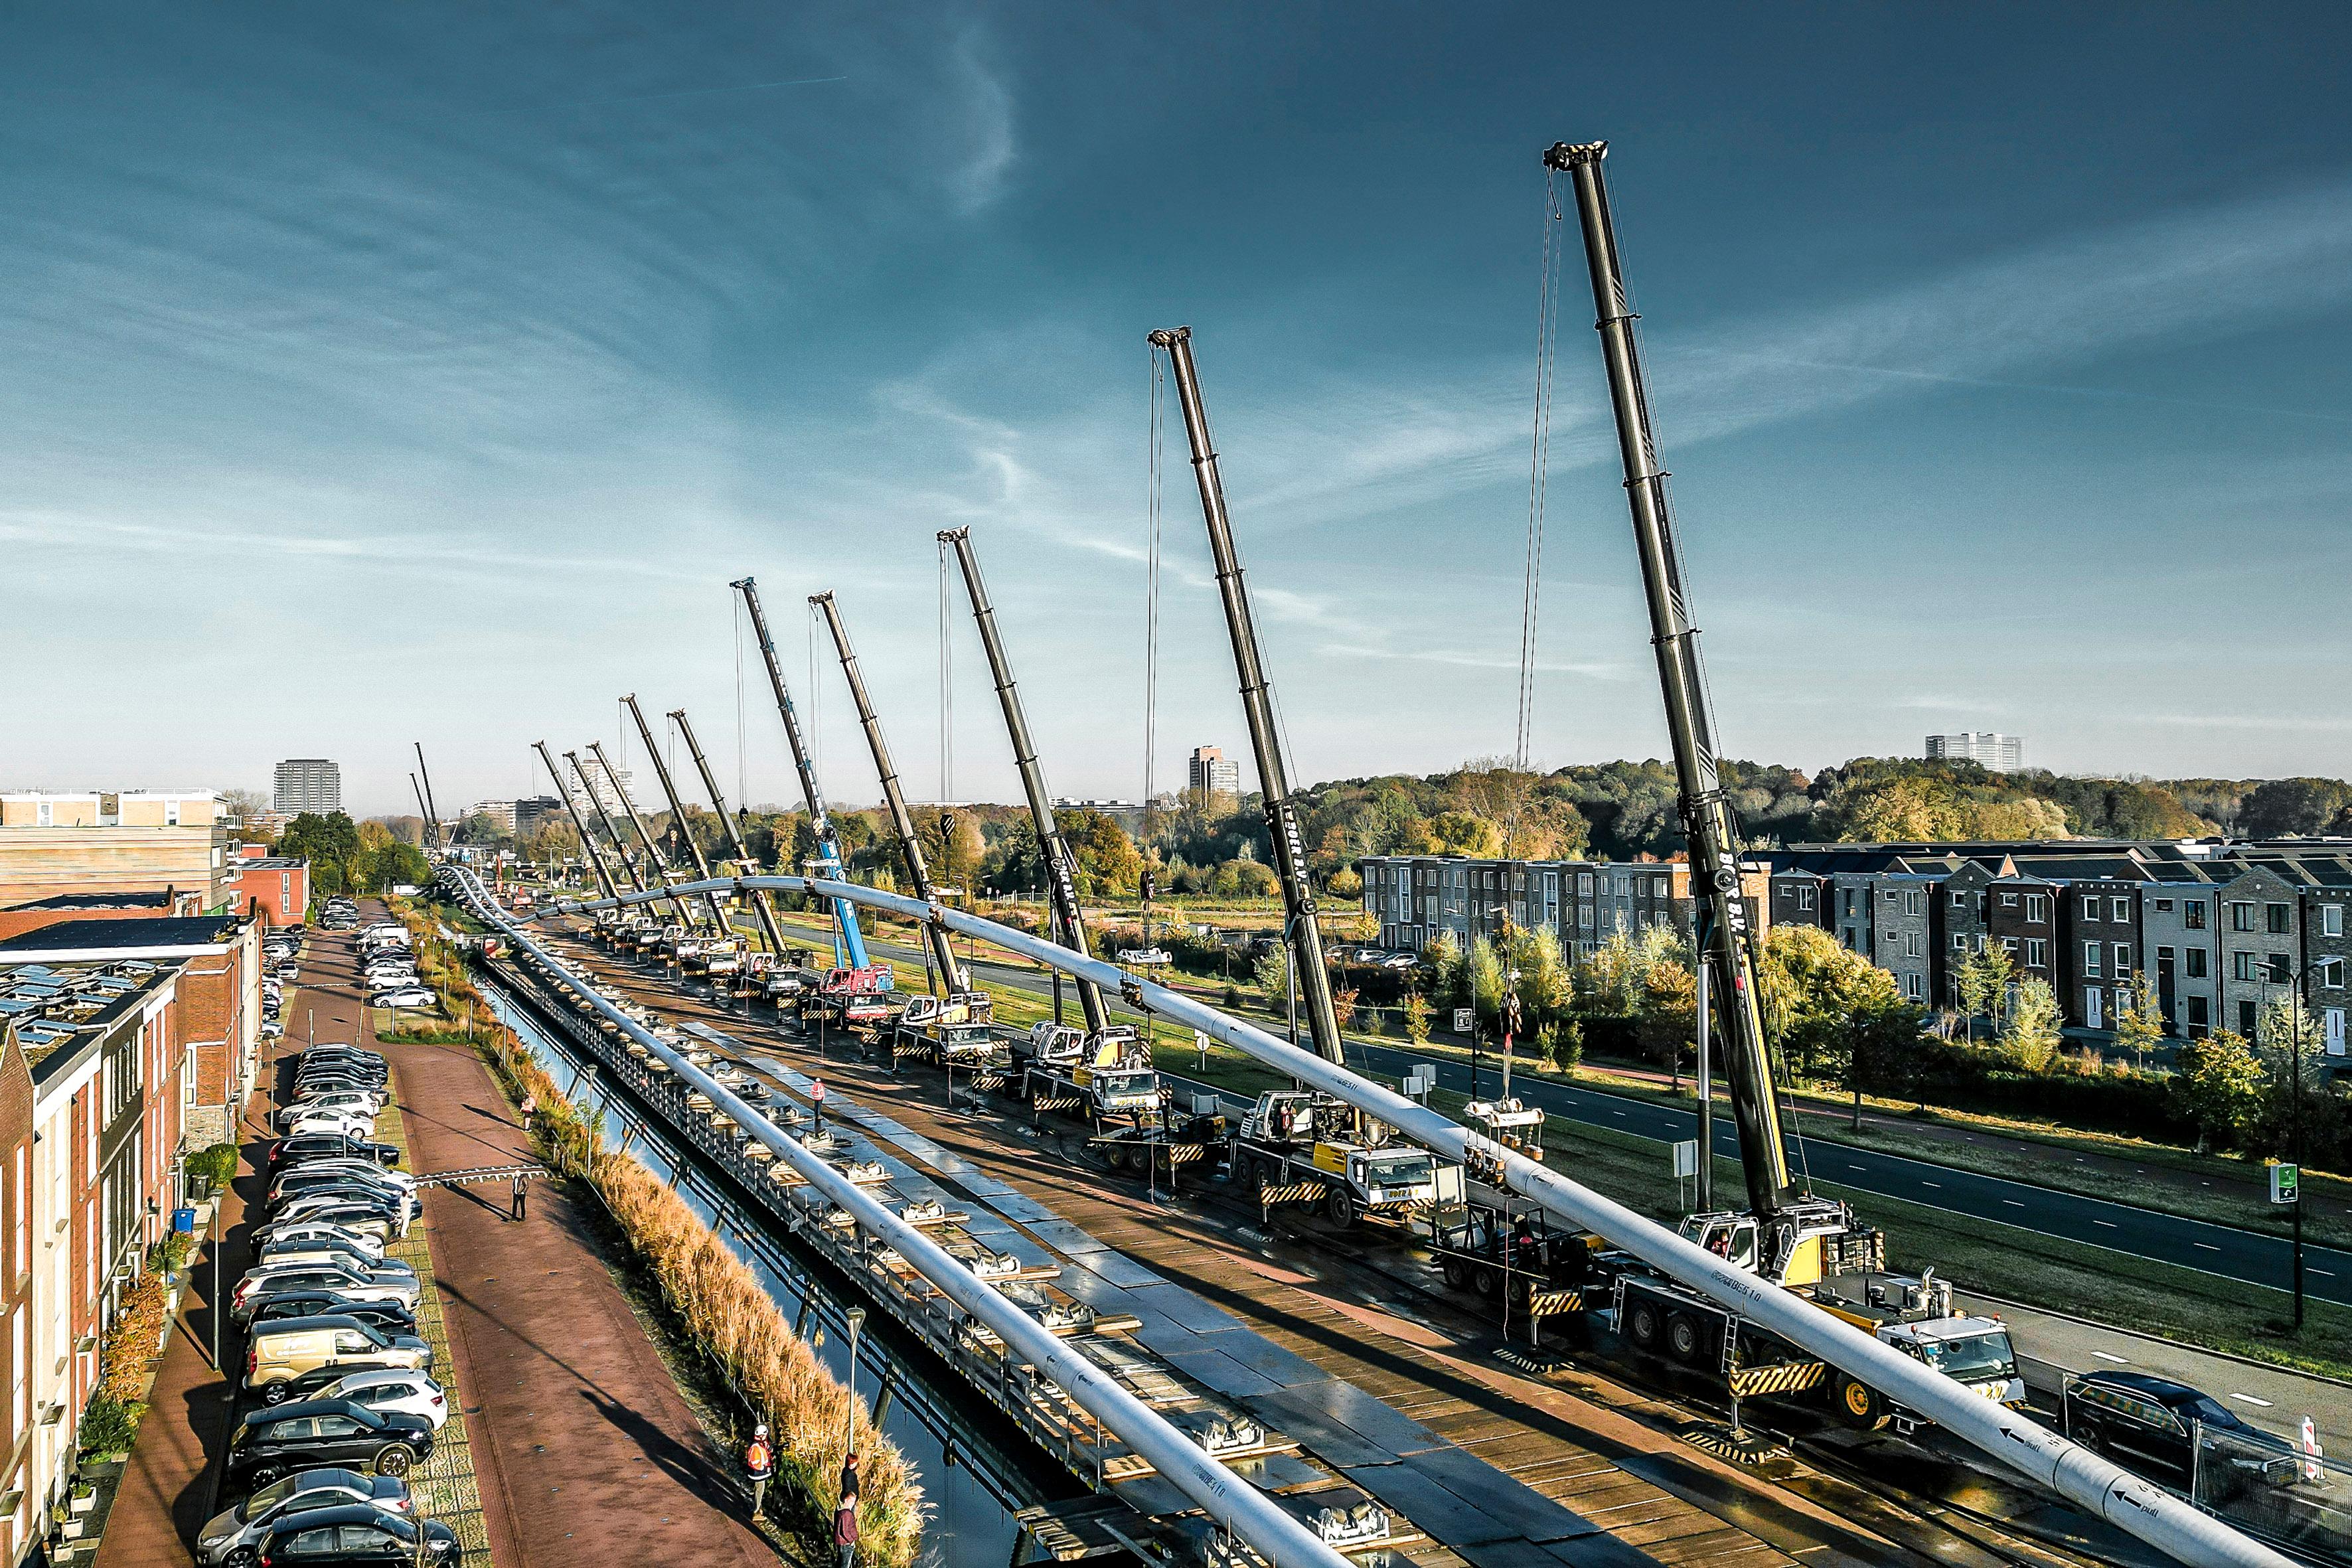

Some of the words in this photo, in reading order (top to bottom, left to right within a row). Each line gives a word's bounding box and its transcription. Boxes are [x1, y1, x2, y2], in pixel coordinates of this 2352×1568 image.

[1285, 821, 1302, 855] BOER
[1293, 858, 1308, 882] B.V.
[1719, 852, 1741, 899] BR
[1727, 902, 1746, 932] B.V.
[2140, 1504, 2160, 1518] pull
